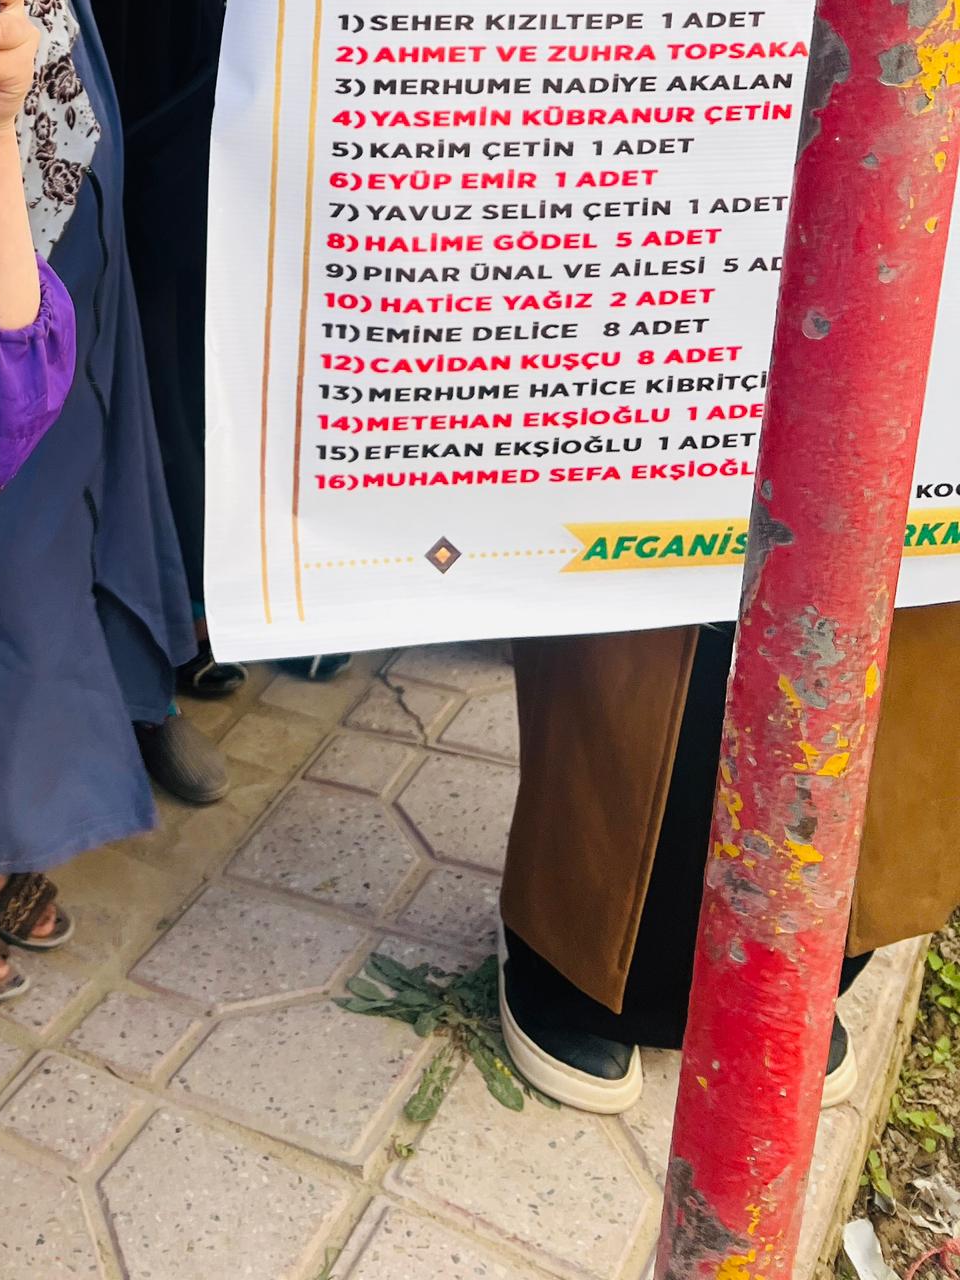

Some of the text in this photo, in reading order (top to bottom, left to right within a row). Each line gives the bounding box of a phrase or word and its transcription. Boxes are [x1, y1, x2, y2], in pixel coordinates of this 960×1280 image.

[485, 14, 644, 30] KIZILTEPE
[661, 13, 673, 28] 1
[682, 12, 766, 28] ADET
[495, 46, 537, 62] VE
[547, 45, 657, 62] ZUHRA
[666, 42, 809, 60] TOPSAKA
[542, 74, 658, 93] NADİYE
[666, 74, 793, 91] AKALAN
[521, 106, 696, 126] KÜBRANUR
[703, 101, 793, 125] ÇETİN
[482, 138, 574, 160] ÇETİN
[592, 141, 603, 155] 1
[613, 138, 695, 155] ADET
[460, 169, 537, 189] EMİR
[554, 172, 567, 188] 1
[575, 170, 659, 188] ADET
[482, 200, 573, 219] SELİM
[582, 198, 671, 221] ÇETİN
[688, 199, 699, 214] 1
[709, 196, 789, 213] ADET
[493, 231, 596, 251] GÖDEL
[615, 232, 633, 248] 5
[641, 228, 723, 247] ADET
[470, 263, 553, 281] ÜNAL
[563, 264, 601, 278] VE
[609, 257, 706, 277] AİLESİ
[722, 258, 739, 272] 5
[502, 291, 593, 310] YAĞIZ
[609, 292, 628, 307] 2
[635, 288, 716, 306] ADET
[472, 322, 579, 341] DELİCE
[602, 322, 621, 337] 8
[628, 319, 710, 336] ADET
[520, 352, 621, 371] KUŞÇU
[636, 350, 655, 365] 8
[663, 346, 743, 364] ADET
[529, 379, 637, 398] HATİCE
[522, 406, 671, 429] EKŞİOĞLU
[687, 407, 698, 421] 1
[706, 405, 764, 420] ADE
[494, 436, 643, 457] EKŞİOĞLU
[658, 436, 669, 450] 1
[677, 433, 757, 450] ADET
[548, 466, 621, 482] SEFA
[630, 458, 755, 481] EKŞİOĞL
[583, 526, 748, 562] AFGANİS
